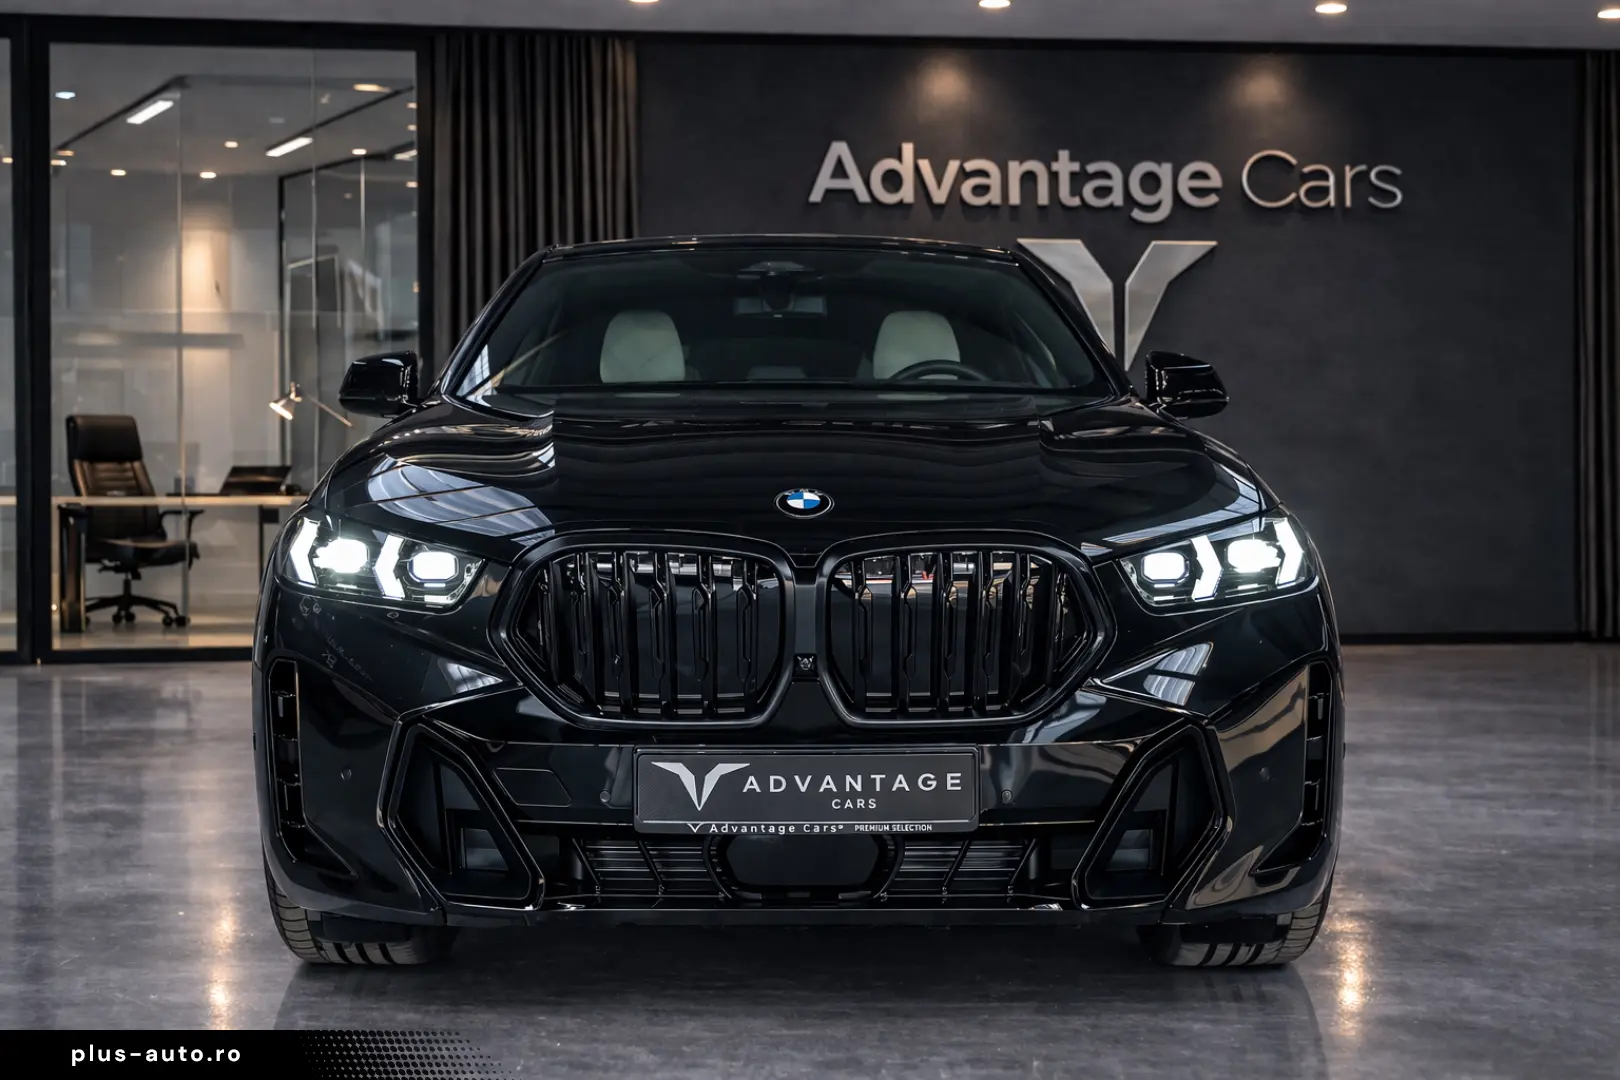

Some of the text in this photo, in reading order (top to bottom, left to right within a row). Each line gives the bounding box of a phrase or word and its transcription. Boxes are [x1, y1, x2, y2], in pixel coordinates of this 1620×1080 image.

[809, 141, 1404, 223] Advantage Cars
[743, 772, 963, 793] ADVANTAGE
[831, 798, 878, 810] CARS
[709, 823, 796, 835] Advantage
[891, 823, 933, 832] SELECTION
